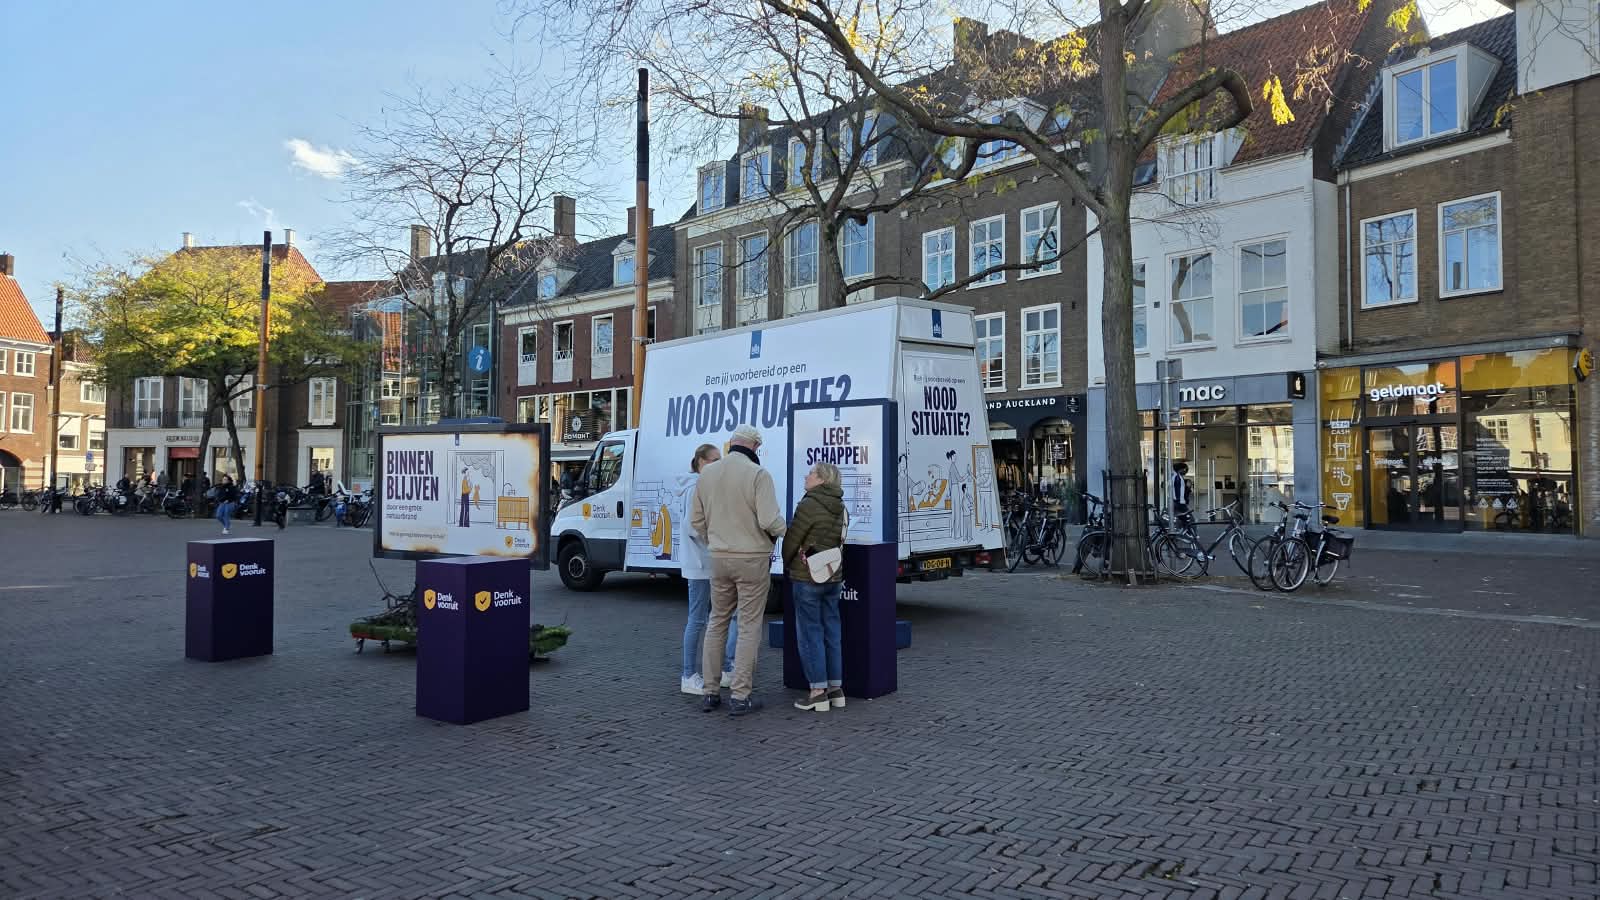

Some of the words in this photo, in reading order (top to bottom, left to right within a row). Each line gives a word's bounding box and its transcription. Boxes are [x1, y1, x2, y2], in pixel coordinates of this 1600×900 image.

[705, 375, 720, 386] Ben
[721, 372, 729, 386] jij
[729, 364, 776, 383] voorbereid
[776, 366, 789, 378] op
[790, 363, 807, 374] een
[923, 386, 958, 411] NOOD
[1370, 382, 1446, 401] geldmaat
[1006, 398, 1056, 409] AUCKLAND
[911, 411, 971, 436] SITUATIE?
[823, 427, 851, 446] LEGE
[387, 450, 434, 475] BINNEN
[806, 446, 869, 465] SCHAPPEN
[386, 476, 439, 501] BLIJVEN
[239, 568, 266, 576] vooruit
[437, 593, 452, 602] Denk
[493, 589, 514, 600] Denk
[494, 596, 522, 607] vooruit
[840, 588, 859, 601] ruit
[437, 601, 459, 610] vooruit
